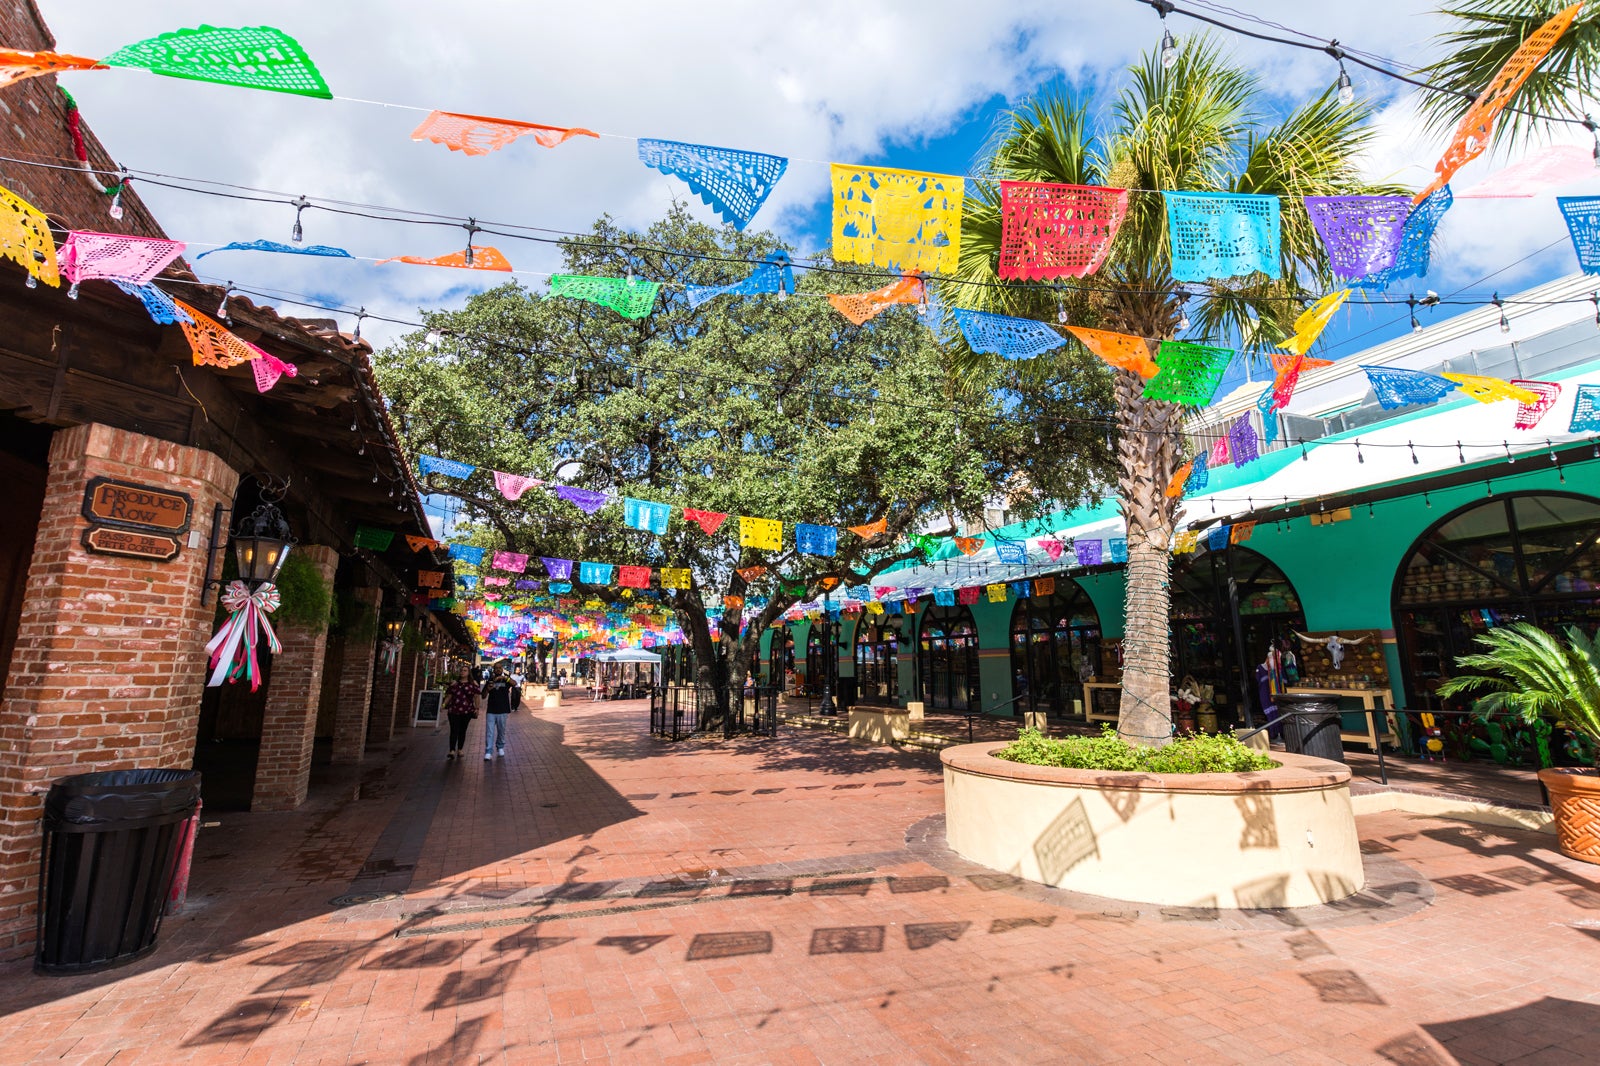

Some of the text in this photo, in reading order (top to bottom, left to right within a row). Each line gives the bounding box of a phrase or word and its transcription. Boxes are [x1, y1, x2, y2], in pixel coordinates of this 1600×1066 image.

[101, 487, 181, 511] PRODUCE
[108, 500, 157, 522] ROW
[98, 539, 167, 555] PETE CORTEZ
[99, 532, 156, 546] PASEO DE
